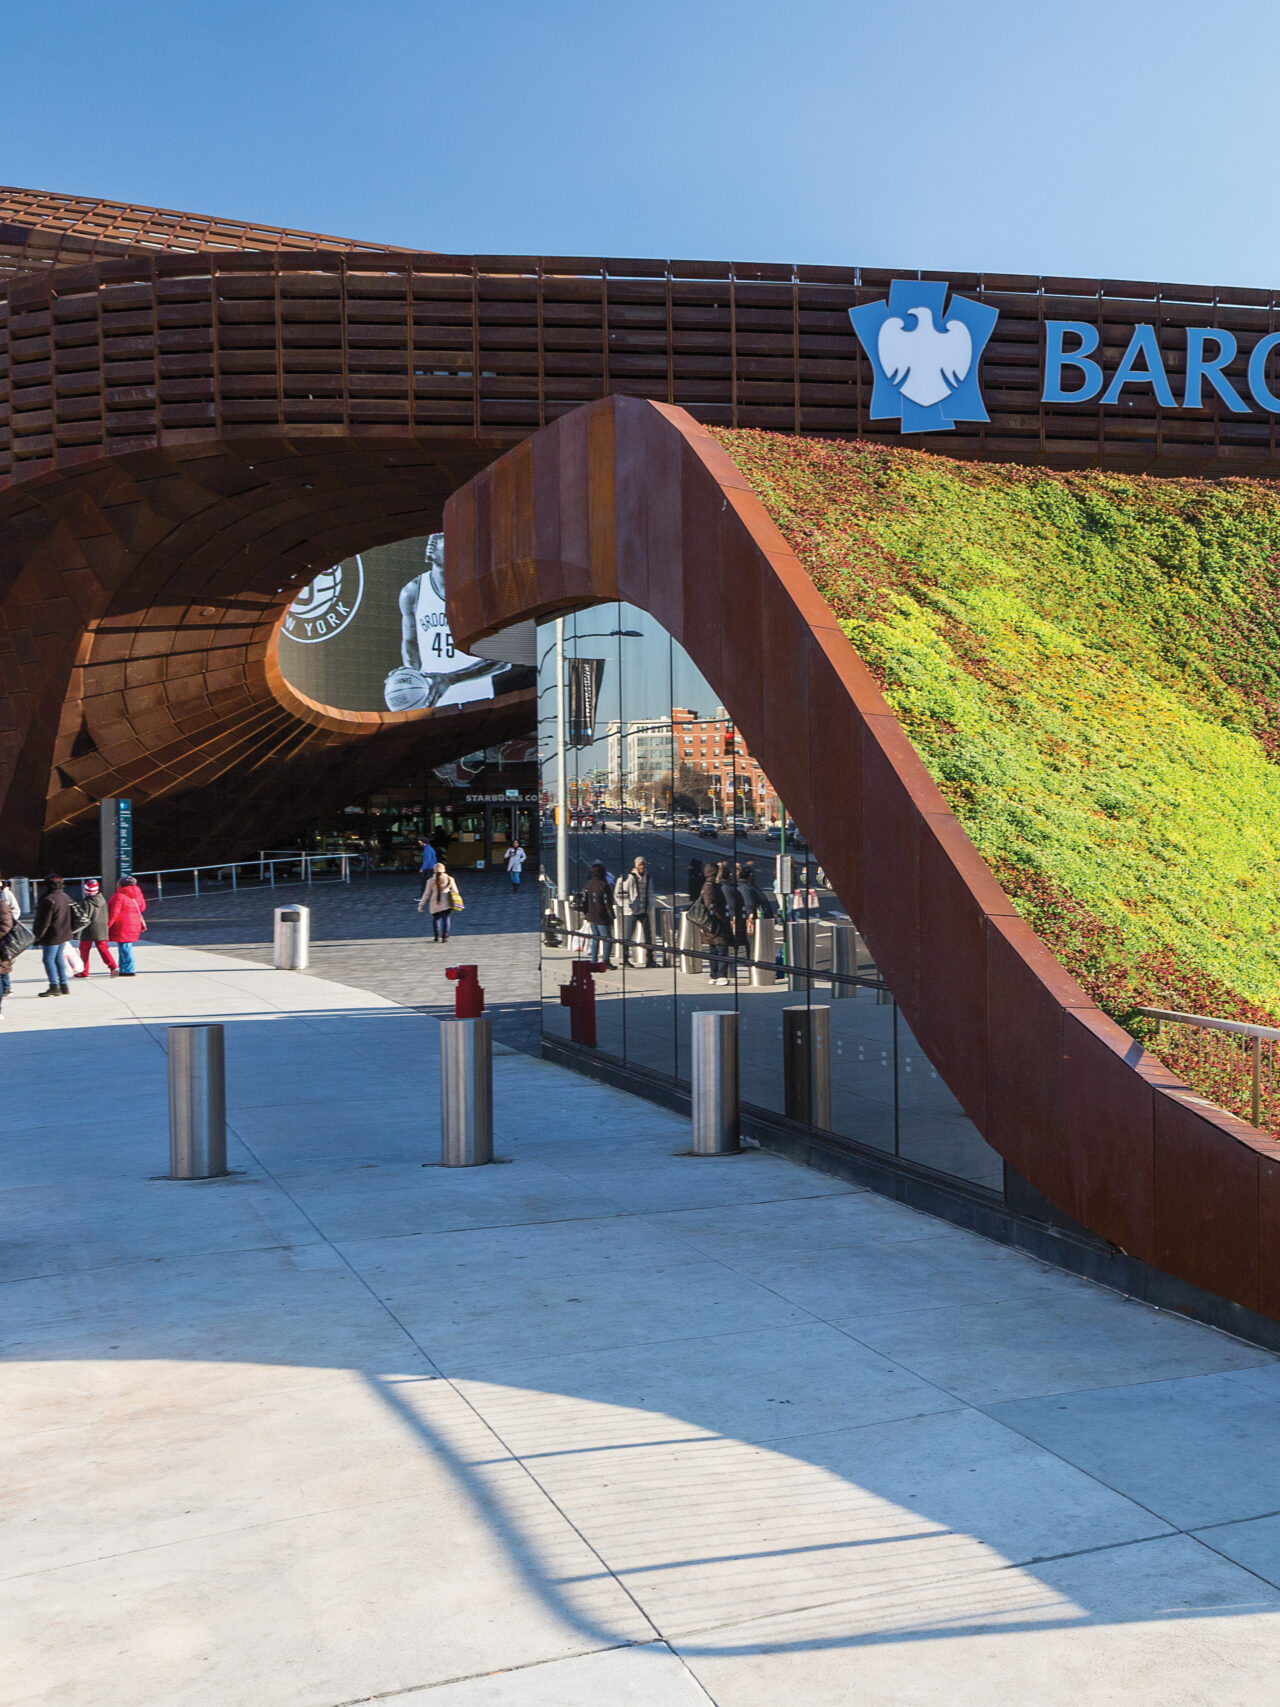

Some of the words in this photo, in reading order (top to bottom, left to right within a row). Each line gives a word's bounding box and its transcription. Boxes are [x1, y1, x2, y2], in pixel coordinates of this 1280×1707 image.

[304, 601, 350, 637] YORK
[420, 612, 448, 632] BROO
[432, 632, 455, 658] 45
[465, 794, 523, 802] STARBUCKS
